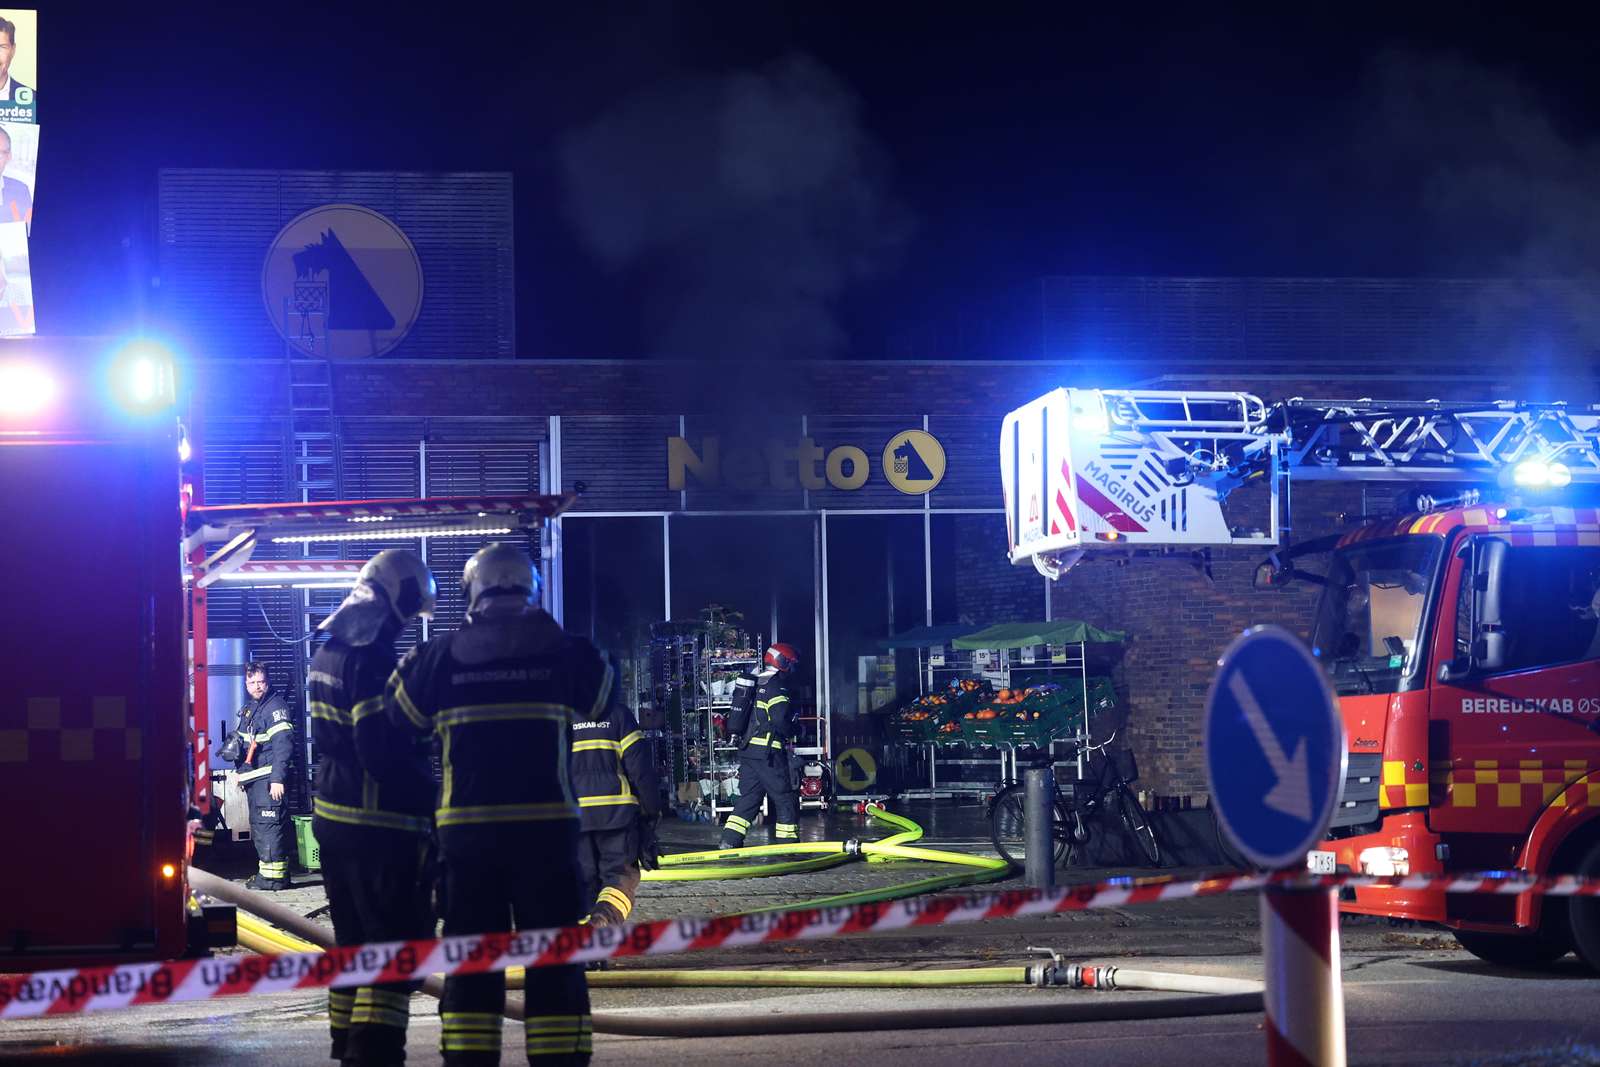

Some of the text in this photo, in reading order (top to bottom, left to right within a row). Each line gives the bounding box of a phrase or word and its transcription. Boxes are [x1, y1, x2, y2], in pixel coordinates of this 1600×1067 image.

[19, 90, 28, 101] C
[0, 106, 32, 117] ordes
[1084, 460, 1156, 523] MAGIRUS
[1462, 698, 1600, 713] BEREDSKAB ØS
[572, 721, 596, 730] DSKAB
[445, 924, 652, 964] Brandvæsen
[202, 946, 419, 987] Brandvæsen
[0, 966, 174, 1006] Brandvæs
